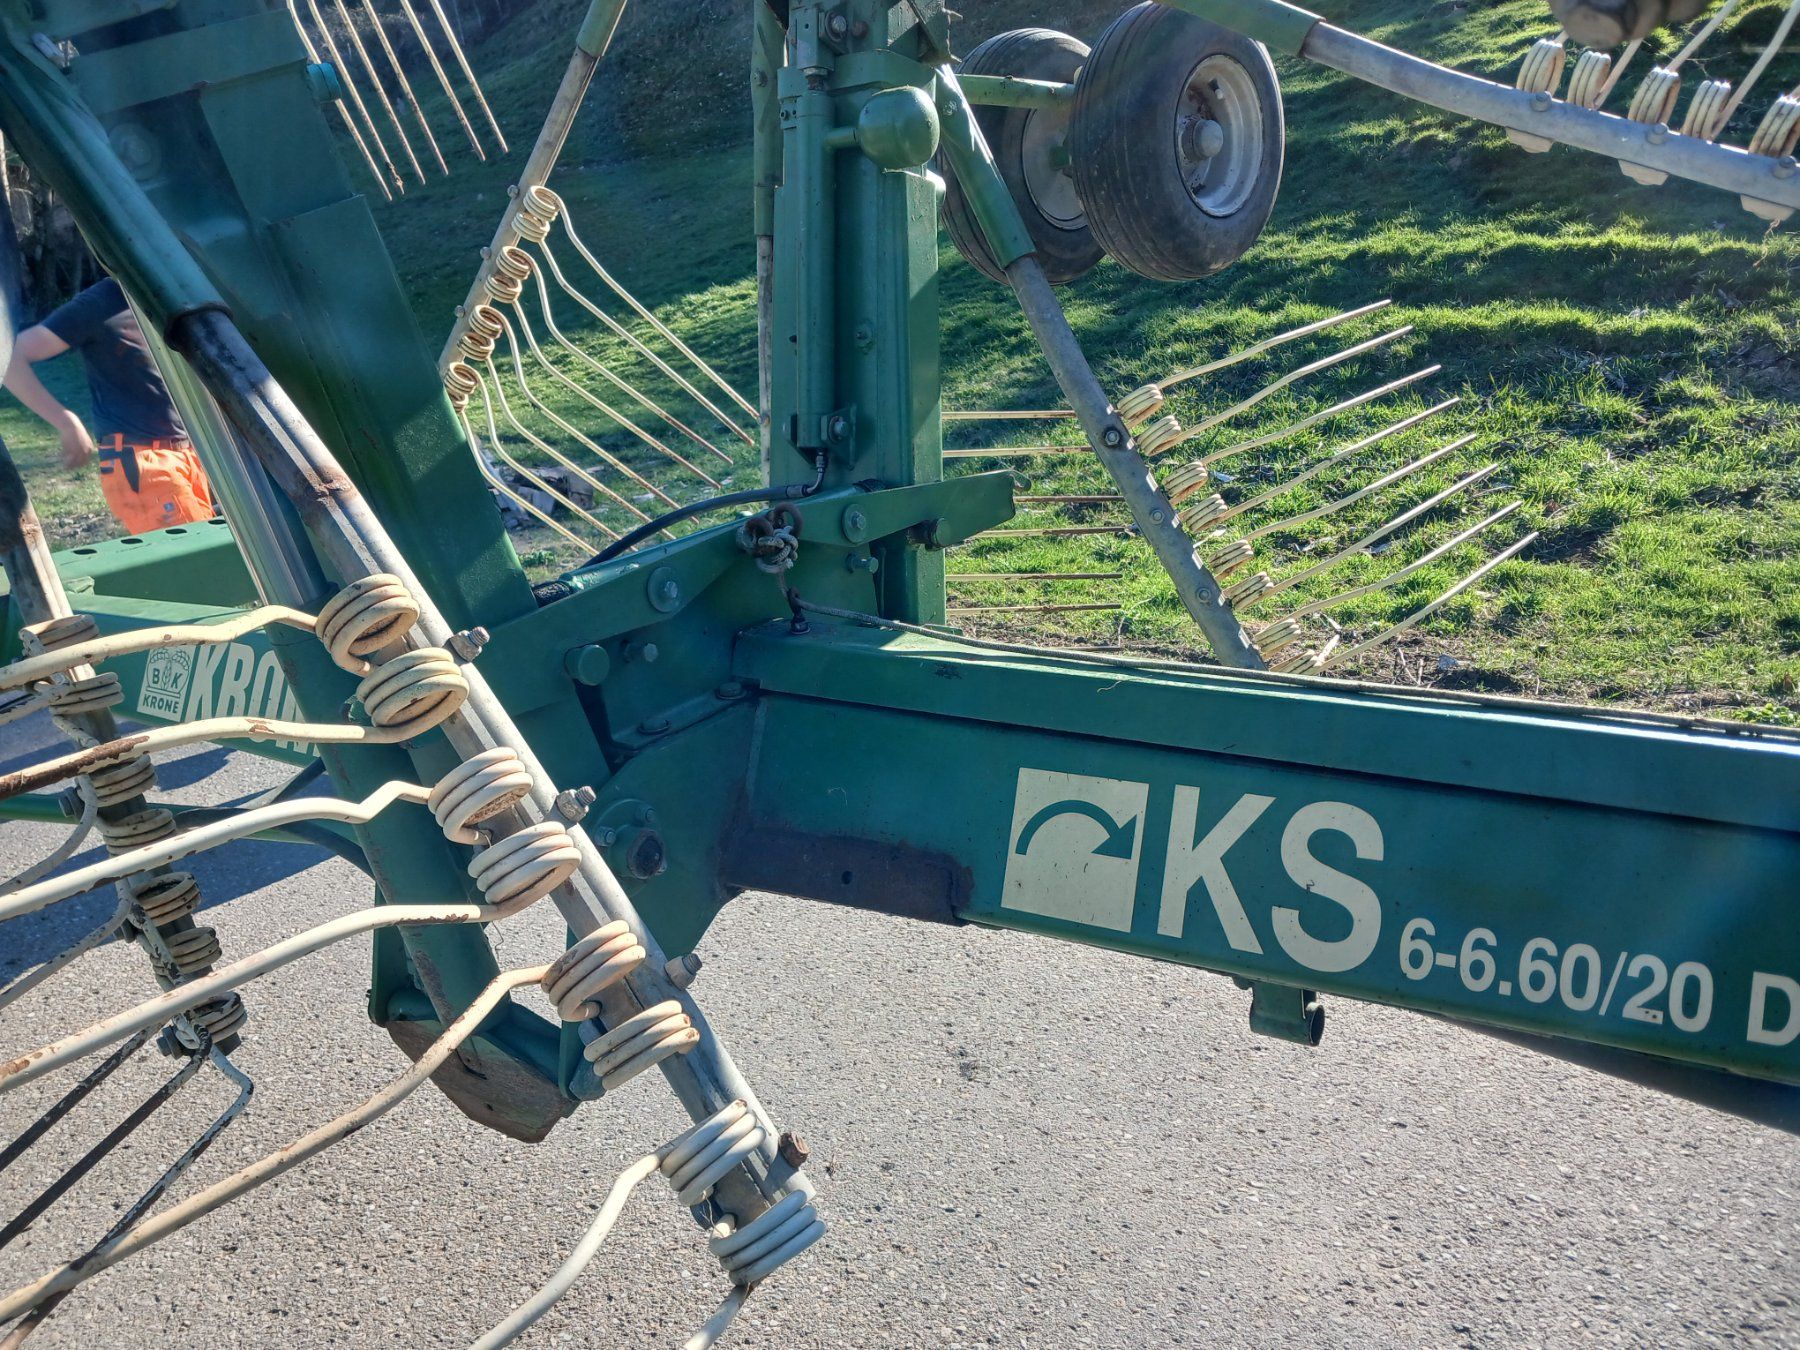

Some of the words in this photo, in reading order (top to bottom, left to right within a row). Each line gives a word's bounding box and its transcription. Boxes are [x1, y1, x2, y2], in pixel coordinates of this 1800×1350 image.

[142, 693, 180, 714] KRONE
[152, 667, 160, 684] B
[171, 672, 182, 689] K
[184, 641, 321, 758] KRO
[1157, 784, 1385, 973] KS
[1400, 917, 1714, 1033] 6-6.60/20
[1746, 971, 1800, 1047] D
